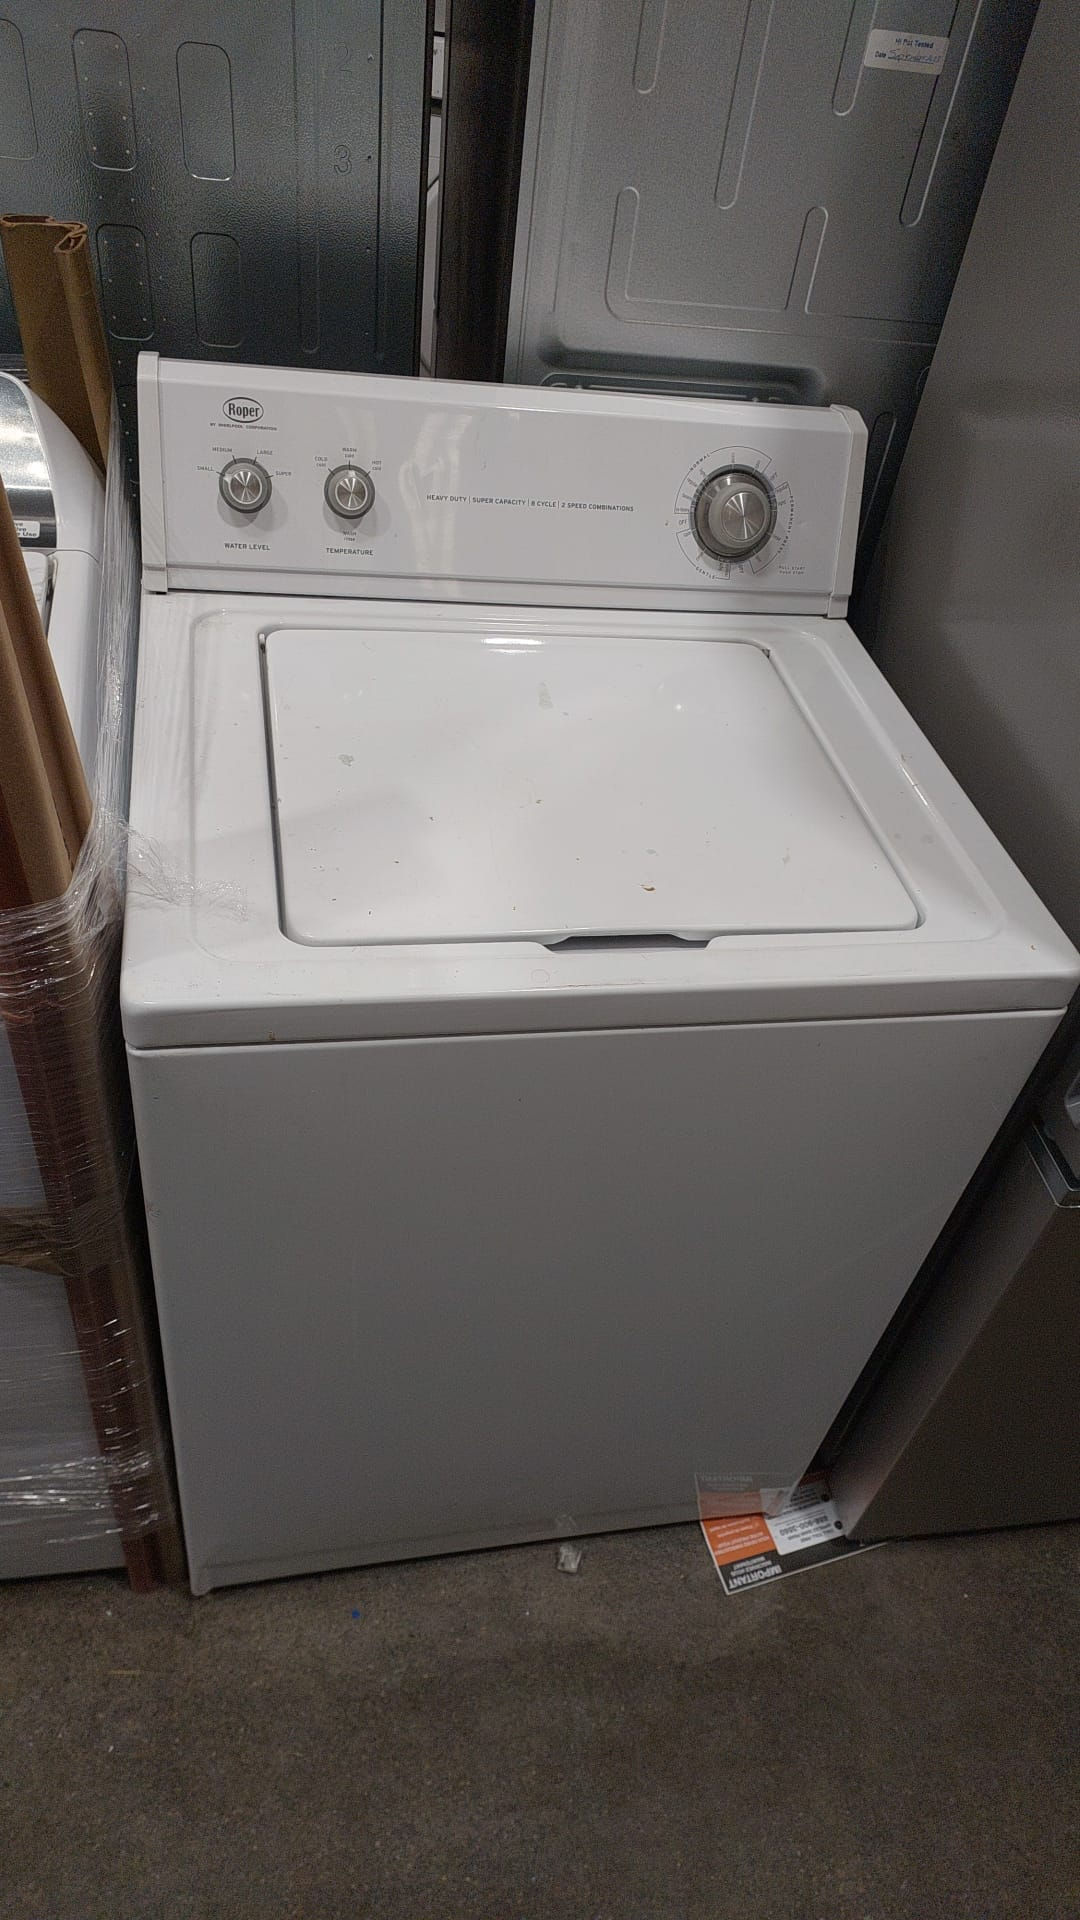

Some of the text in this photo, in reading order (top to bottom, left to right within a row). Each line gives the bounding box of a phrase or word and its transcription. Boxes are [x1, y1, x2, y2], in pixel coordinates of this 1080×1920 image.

[914, 40, 935, 49] Tested
[227, 402, 261, 419] Roper
[688, 452, 712, 471] NORMAL
[472, 496, 494, 504] SUPER
[495, 498, 526, 506] CAPACITY
[536, 500, 557, 508] CYCLE
[588, 503, 634, 512] COMBINATIONS
[325, 547, 374, 556] TEMPERATURE
[695, 565, 716, 580] GENTLE
[728, 1565, 783, 1589] IMPORTANT
